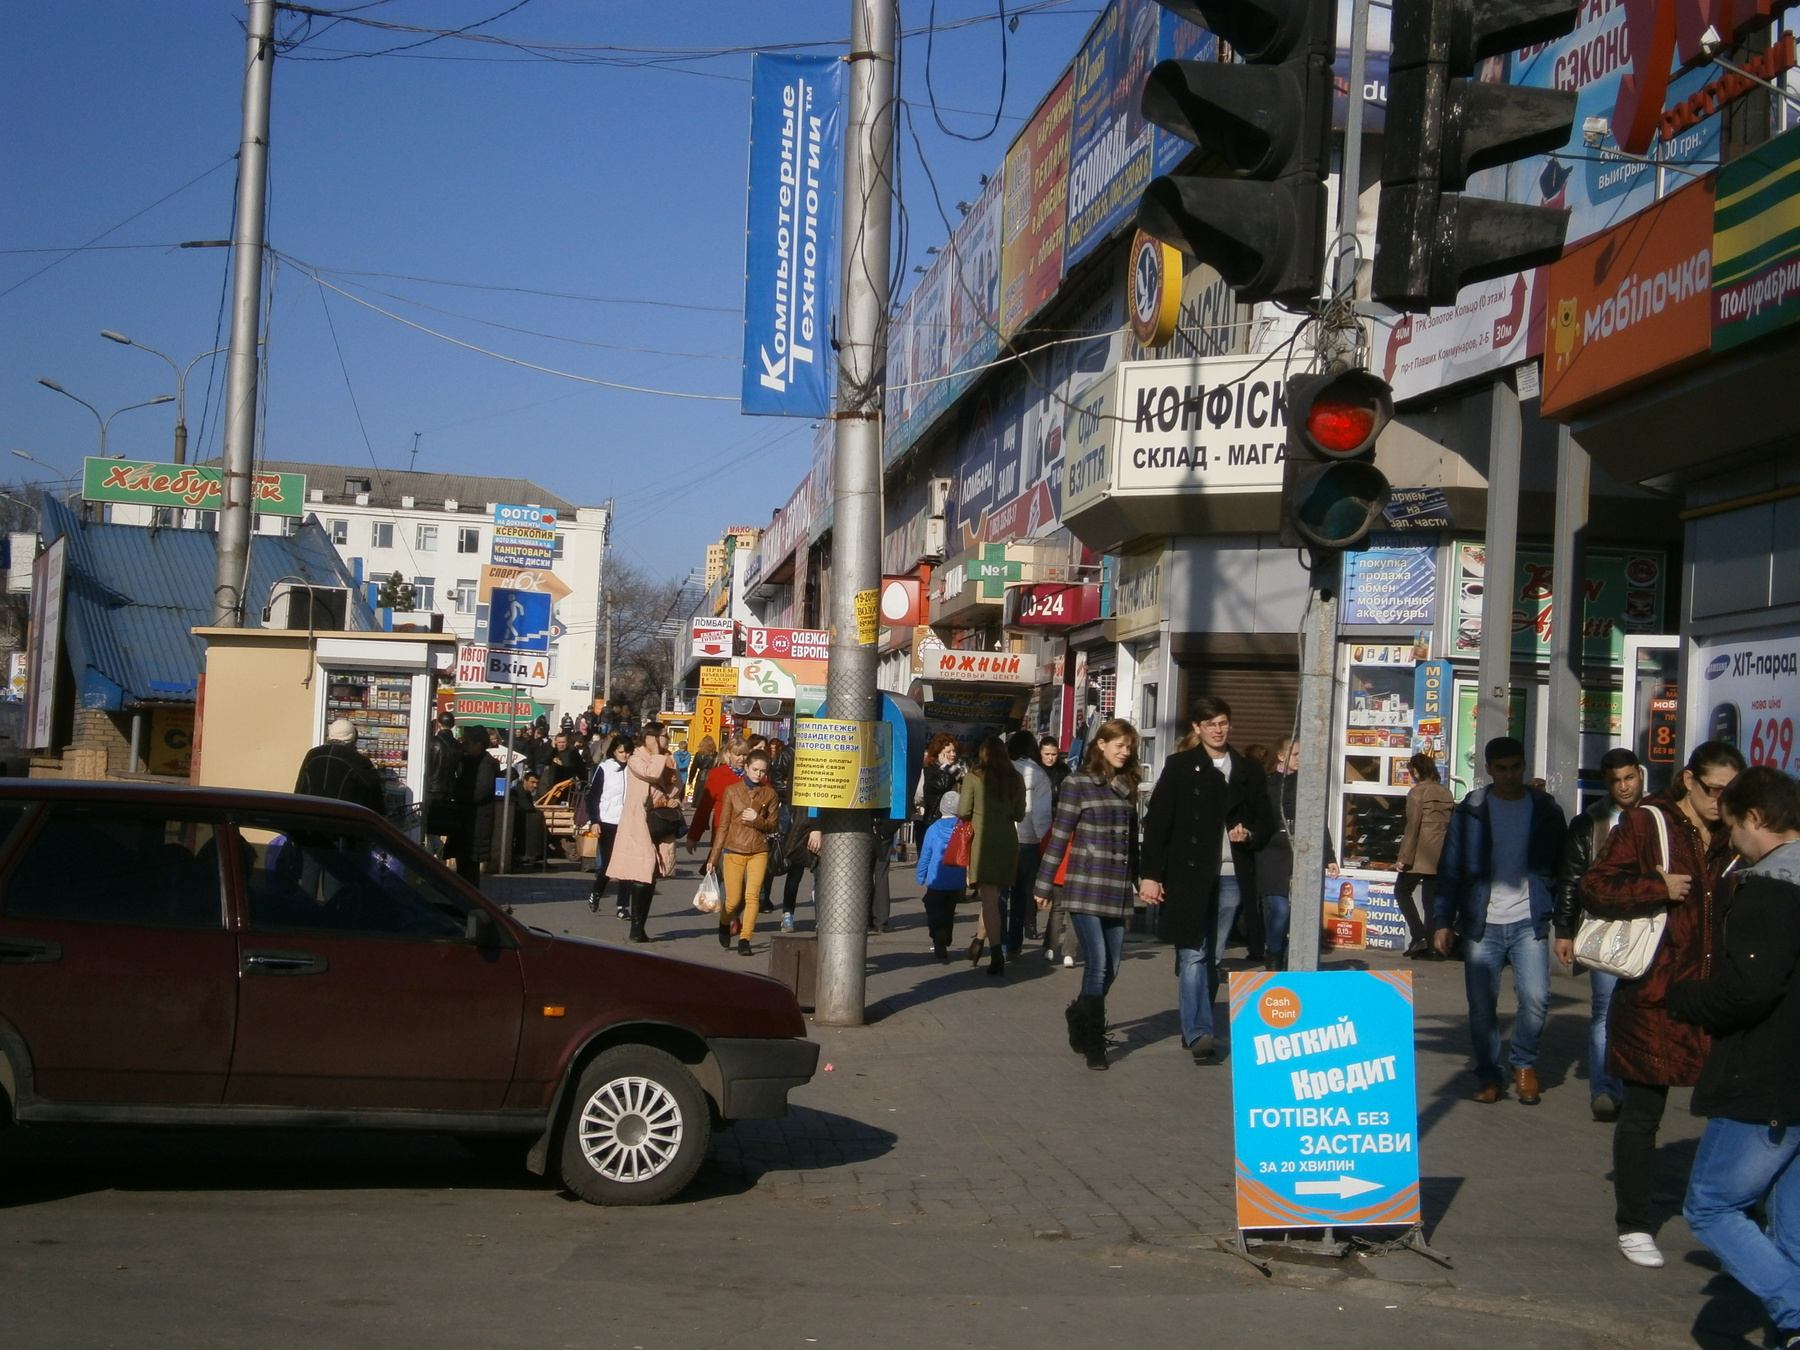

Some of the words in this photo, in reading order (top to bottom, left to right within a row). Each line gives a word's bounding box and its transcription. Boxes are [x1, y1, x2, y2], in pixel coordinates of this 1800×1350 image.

[1034, 130, 1069, 193] РЕКЛАМА
[760, 84, 796, 392] Компьютерные
[789, 117, 821, 364] Технологии
[1583, 248, 1710, 346] мобілочка
[1415, 317, 1428, 333] ТРК
[1428, 312, 1453, 329] Золотое
[1454, 301, 1478, 319] Кольцо
[1487, 287, 1506, 306] этаж)
[1395, 327, 1410, 341] 40м
[1495, 324, 1512, 341] 30м
[1400, 361, 1414, 375] пр-т
[1414, 353, 1437, 369] Павших
[1437, 338, 1478, 361] Коммунаров,
[1134, 380, 1288, 434] КОНФІСК
[1077, 395, 1105, 449] ОДЯГ
[1133, 445, 1208, 472] СКЛАД
[1069, 444, 1106, 498] ВЗУТТЯ
[102, 464, 284, 505] Хлебук
[961, 460, 993, 506] ЛОМБАРД
[1391, 491, 1428, 502] прием
[501, 507, 541, 521] ФОТО
[1406, 503, 1420, 514] на
[505, 520, 541, 528] ДОКУМЕНТЫ
[1390, 519, 1413, 528] зап.
[1414, 518, 1448, 527] части
[495, 526, 554, 539] КСЕРОКОПИЯ
[494, 545, 552, 558] КАНЦТОВАРЫ
[493, 555, 524, 565] ЧИСТЫЕ
[524, 558, 551, 567] ДИСКИ
[1359, 559, 1408, 569] покупка
[980, 564, 1009, 577] №1
[1358, 571, 1411, 582] продажа
[1358, 583, 1396, 593] обмен
[1520, 563, 1604, 602] Bn
[1021, 594, 1064, 617] 00-24
[1357, 595, 1429, 605] мобильные
[694, 618, 732, 628] ЛОМБАРД
[1356, 609, 1428, 620] аксессуары
[1512, 603, 1615, 643] Aptit
[755, 631, 764, 644] 2
[775, 640, 787, 648] ИЗ
[791, 631, 829, 645] ОДЕЖД
[490, 658, 528, 678] Вхід
[531, 661, 546, 679] А
[940, 654, 1021, 674] ЮЖНЫЙ
[1707, 660, 1729, 673] SAMSUNG
[1732, 651, 1797, 680] ХІТ-парад
[940, 671, 985, 679] ТОРГОВЫЙ
[1425, 666, 1442, 718] МОБИ
[1751, 700, 1767, 710] нова
[703, 698, 714, 733] ЛОМБ
[811, 723, 857, 732] ПЛАТЕЖЕЙ
[834, 743, 860, 752] СВЯЗИ
[1750, 717, 1794, 770] 629
[1265, 997, 1290, 1007] Cash
[1271, 1009, 1296, 1019] Point
[1253, 1015, 1358, 1065] Легкий
[1291, 1055, 1396, 1101] Кредит
[1250, 1107, 1351, 1128] ГОТІВКА
[1357, 1111, 1390, 1126] БЕЗ
[1299, 1133, 1411, 1155] ЗАСТАВИ
[1259, 1161, 1278, 1173] ЗА
[1280, 1161, 1296, 1173] 20
[1299, 1160, 1356, 1172] ХВИЛИН
